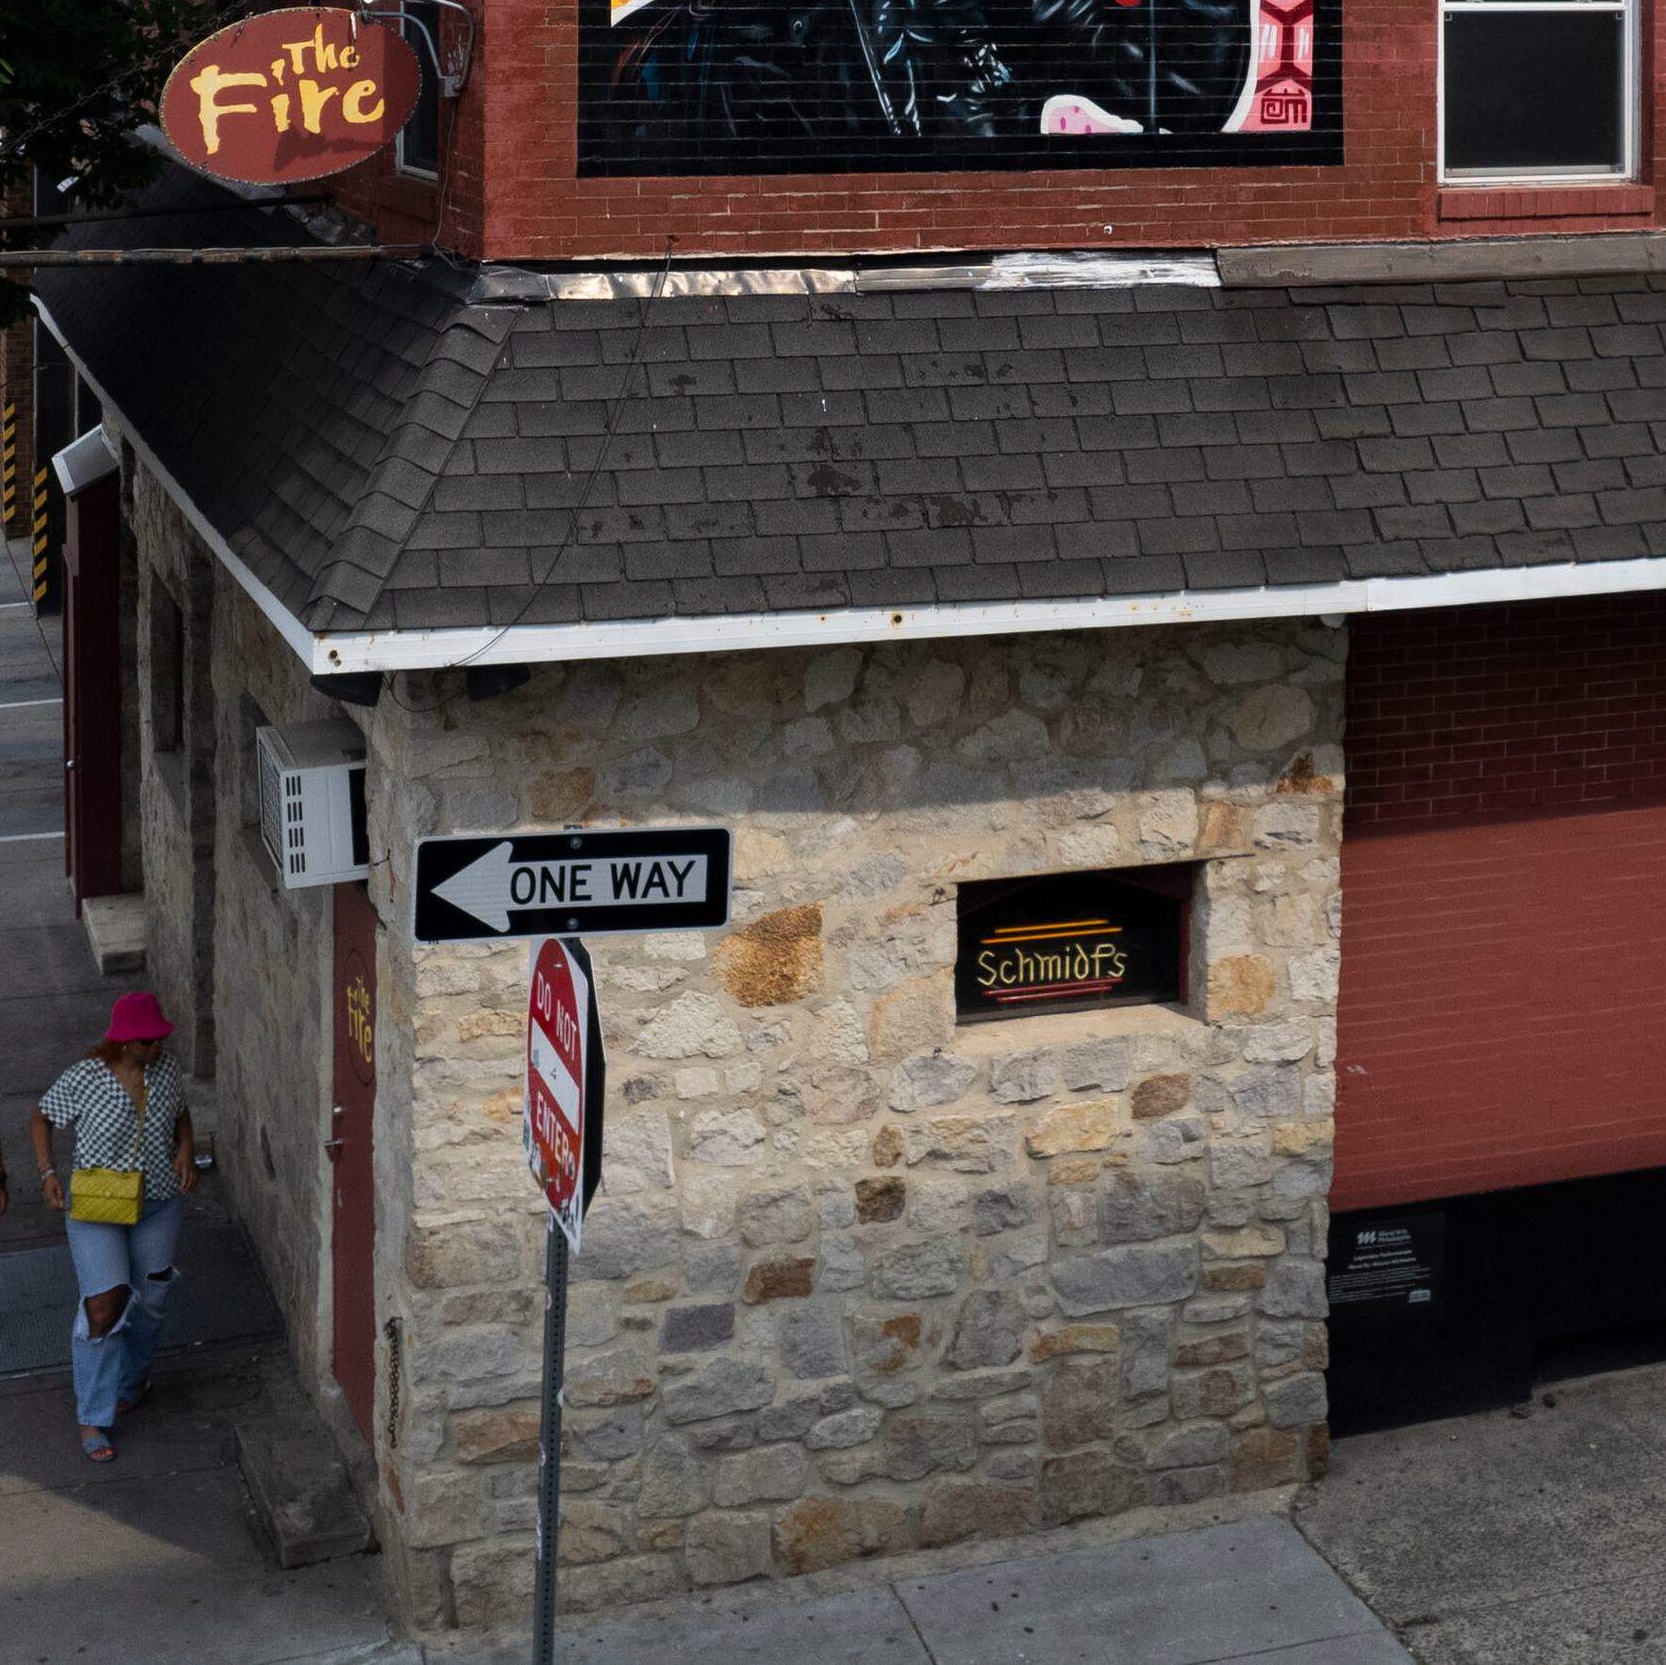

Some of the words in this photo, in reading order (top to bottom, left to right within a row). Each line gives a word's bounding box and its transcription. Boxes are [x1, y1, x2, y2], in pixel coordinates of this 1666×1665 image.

[282, 23, 360, 75] The
[190, 58, 385, 155] Fire
[510, 863, 592, 906] ONE
[610, 859, 696, 900] WAY
[537, 971, 552, 1022] DO
[556, 998, 578, 1062] NOT
[537, 1090, 571, 1170] ENTER
